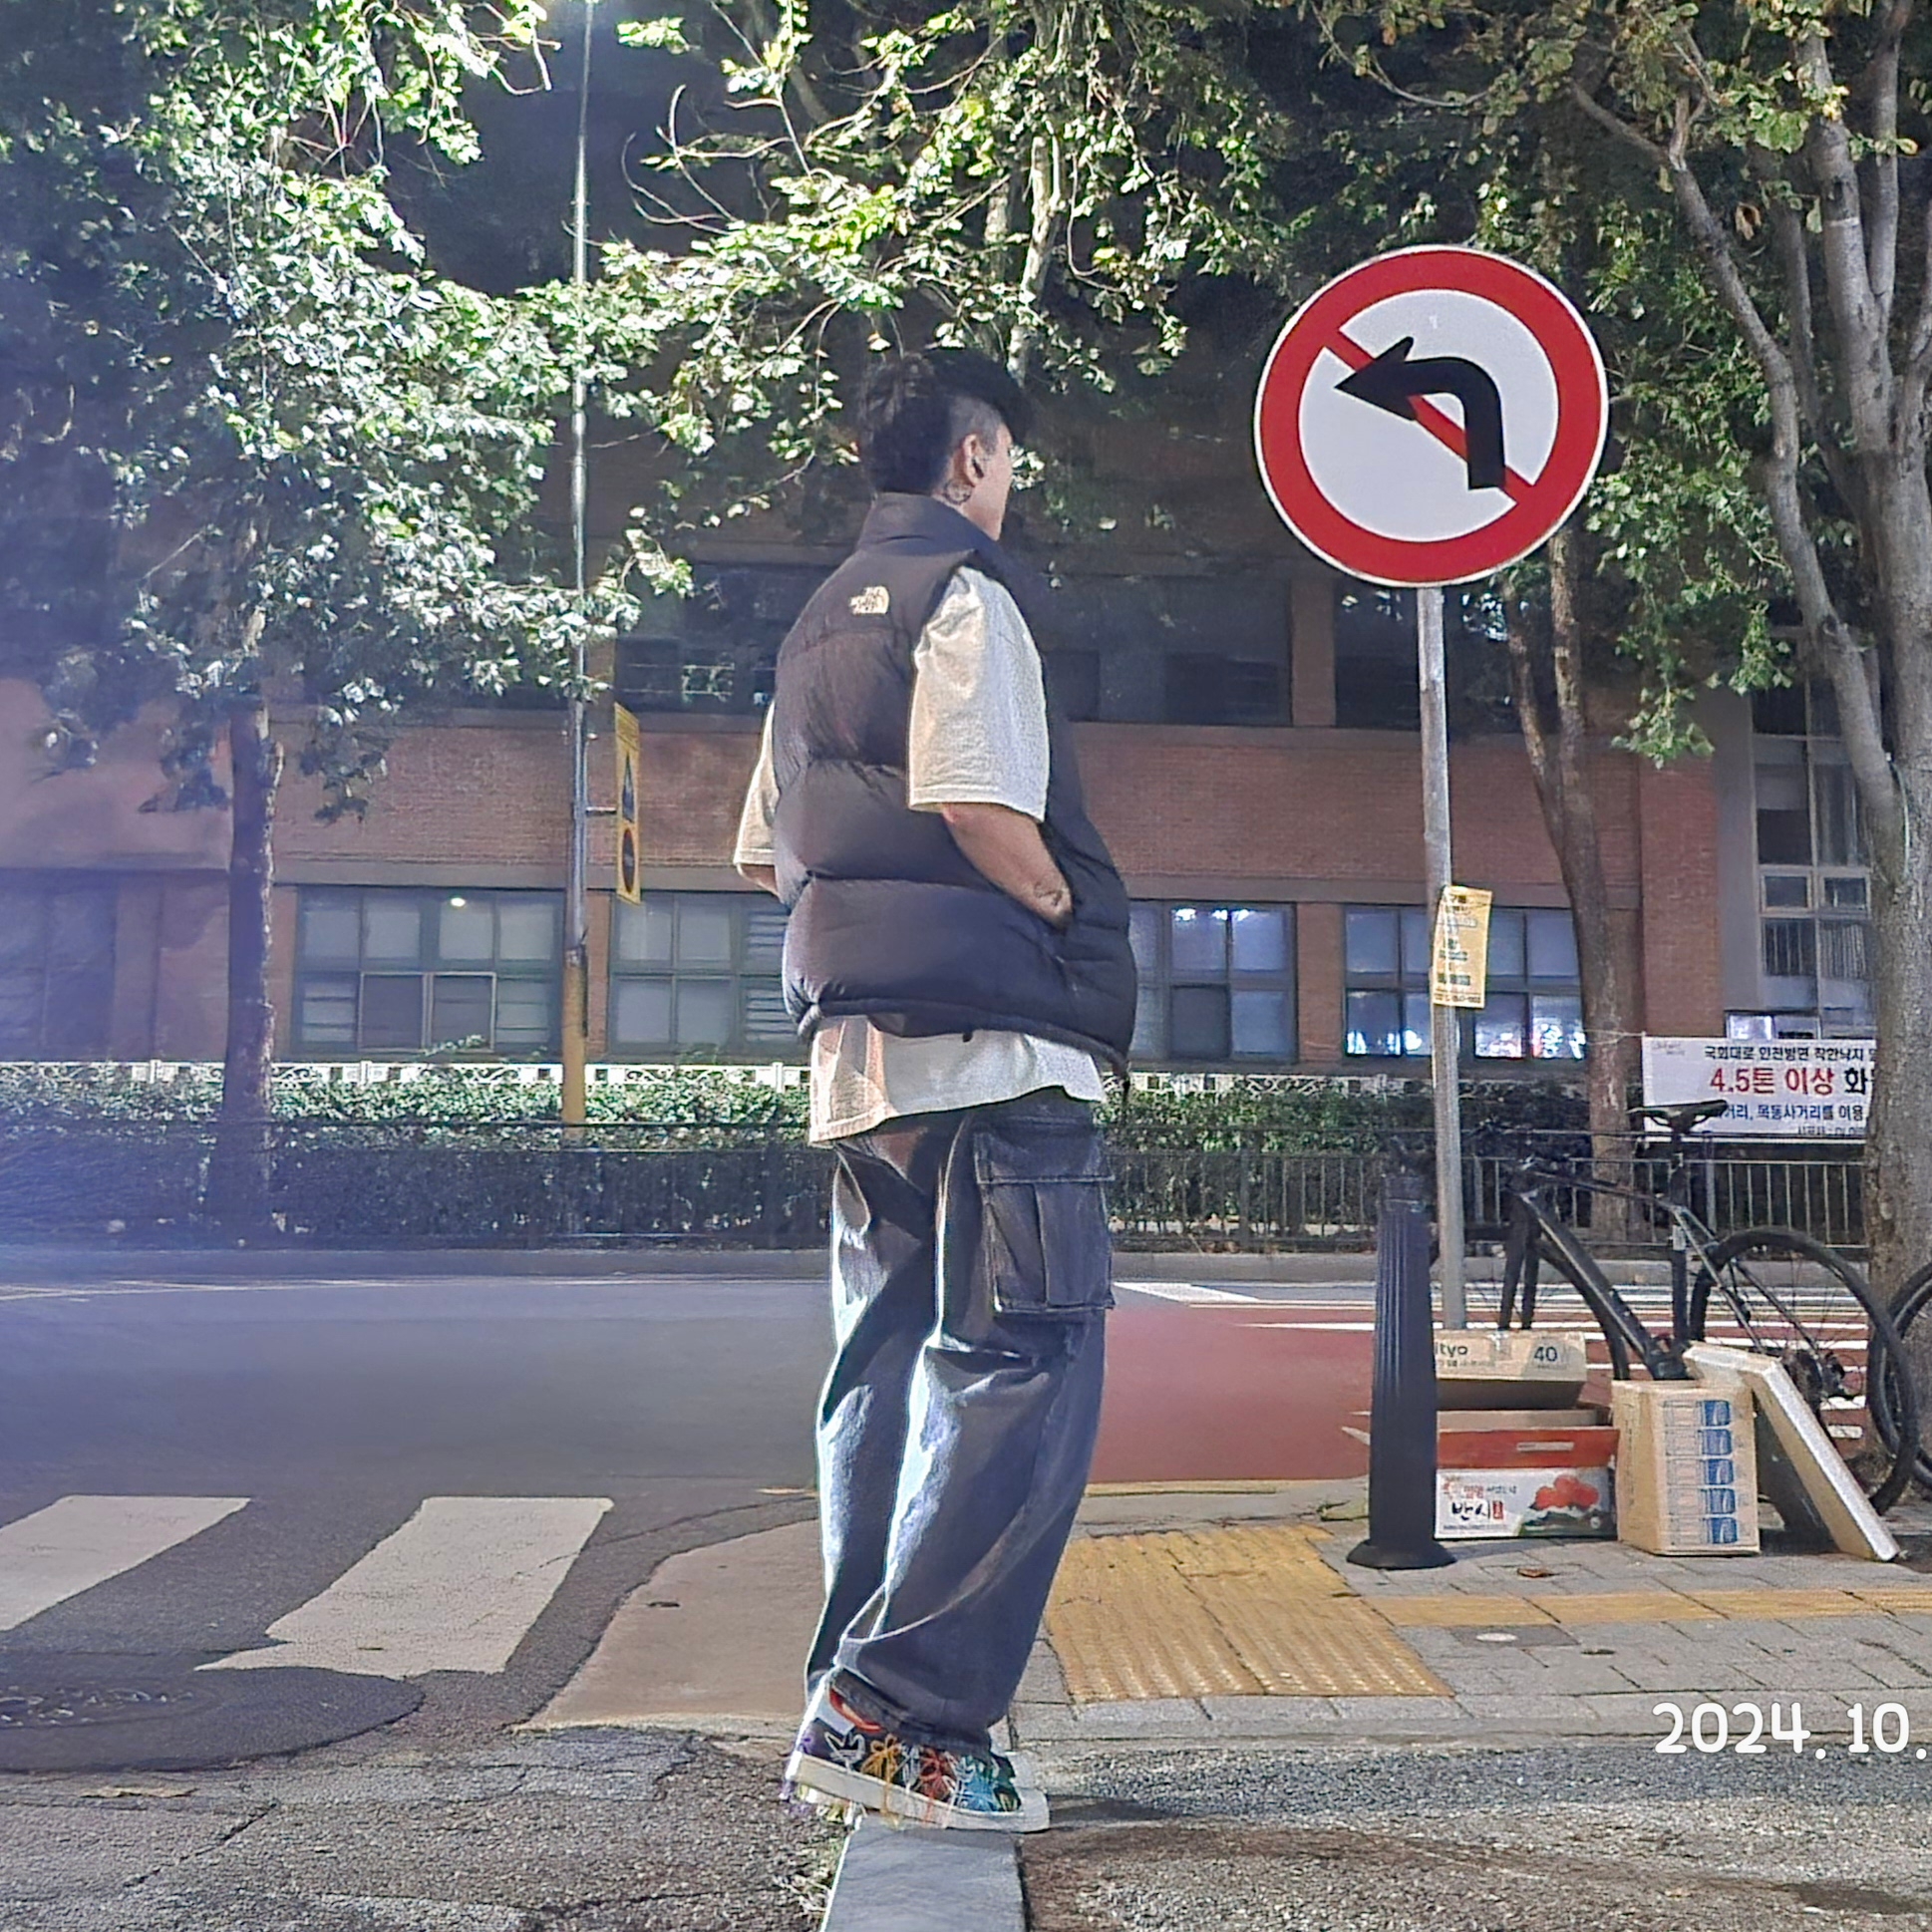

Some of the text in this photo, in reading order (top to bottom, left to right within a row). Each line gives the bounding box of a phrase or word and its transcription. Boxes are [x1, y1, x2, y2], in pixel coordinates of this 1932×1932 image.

[1704, 1045, 1755, 1061] 국회대로
[1759, 1046, 1809, 1062] 인천방면
[1709, 1067, 1875, 1096] 4.5톤 이상 화
[1534, 1346, 1558, 1362] 40
